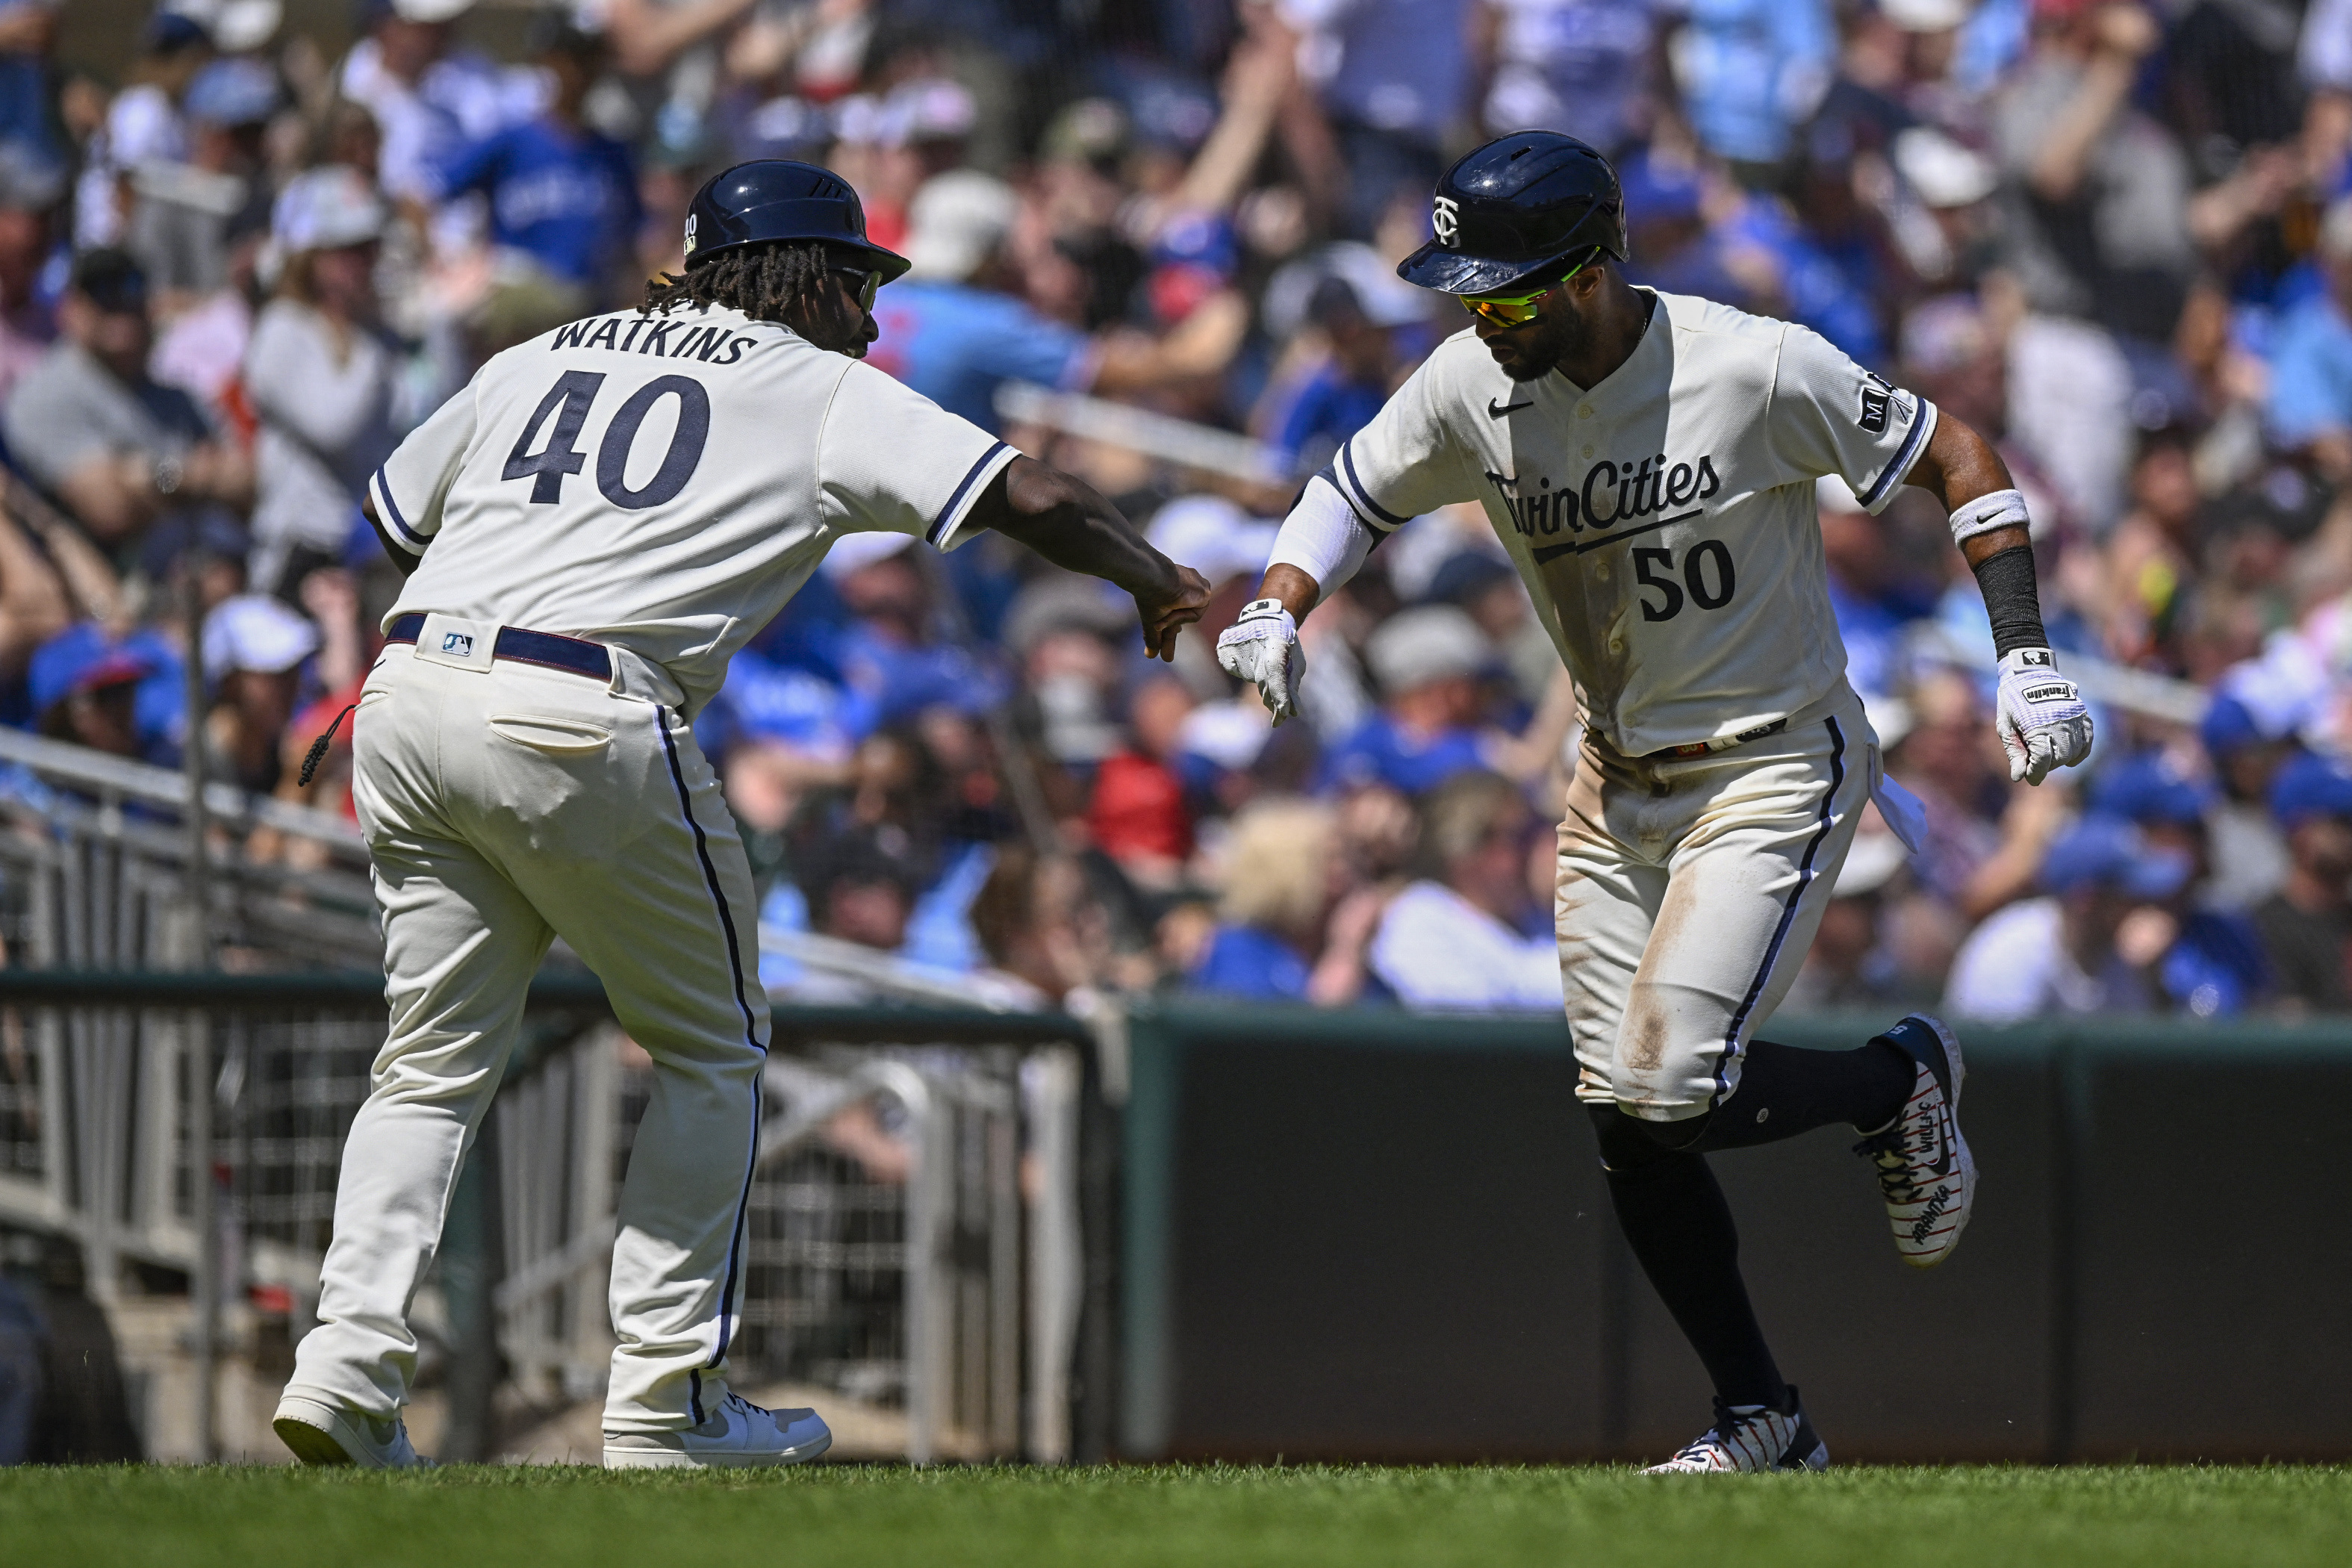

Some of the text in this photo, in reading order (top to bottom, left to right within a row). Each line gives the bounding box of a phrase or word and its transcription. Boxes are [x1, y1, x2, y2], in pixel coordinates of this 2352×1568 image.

[550, 318, 759, 364] WATKINS
[1865, 400, 1883, 423] M
[501, 370, 711, 510] 40
[1631, 539, 1736, 622] 50
[2026, 685, 2071, 699] Franklin
[1911, 1184, 1951, 1245] ARANTXA
